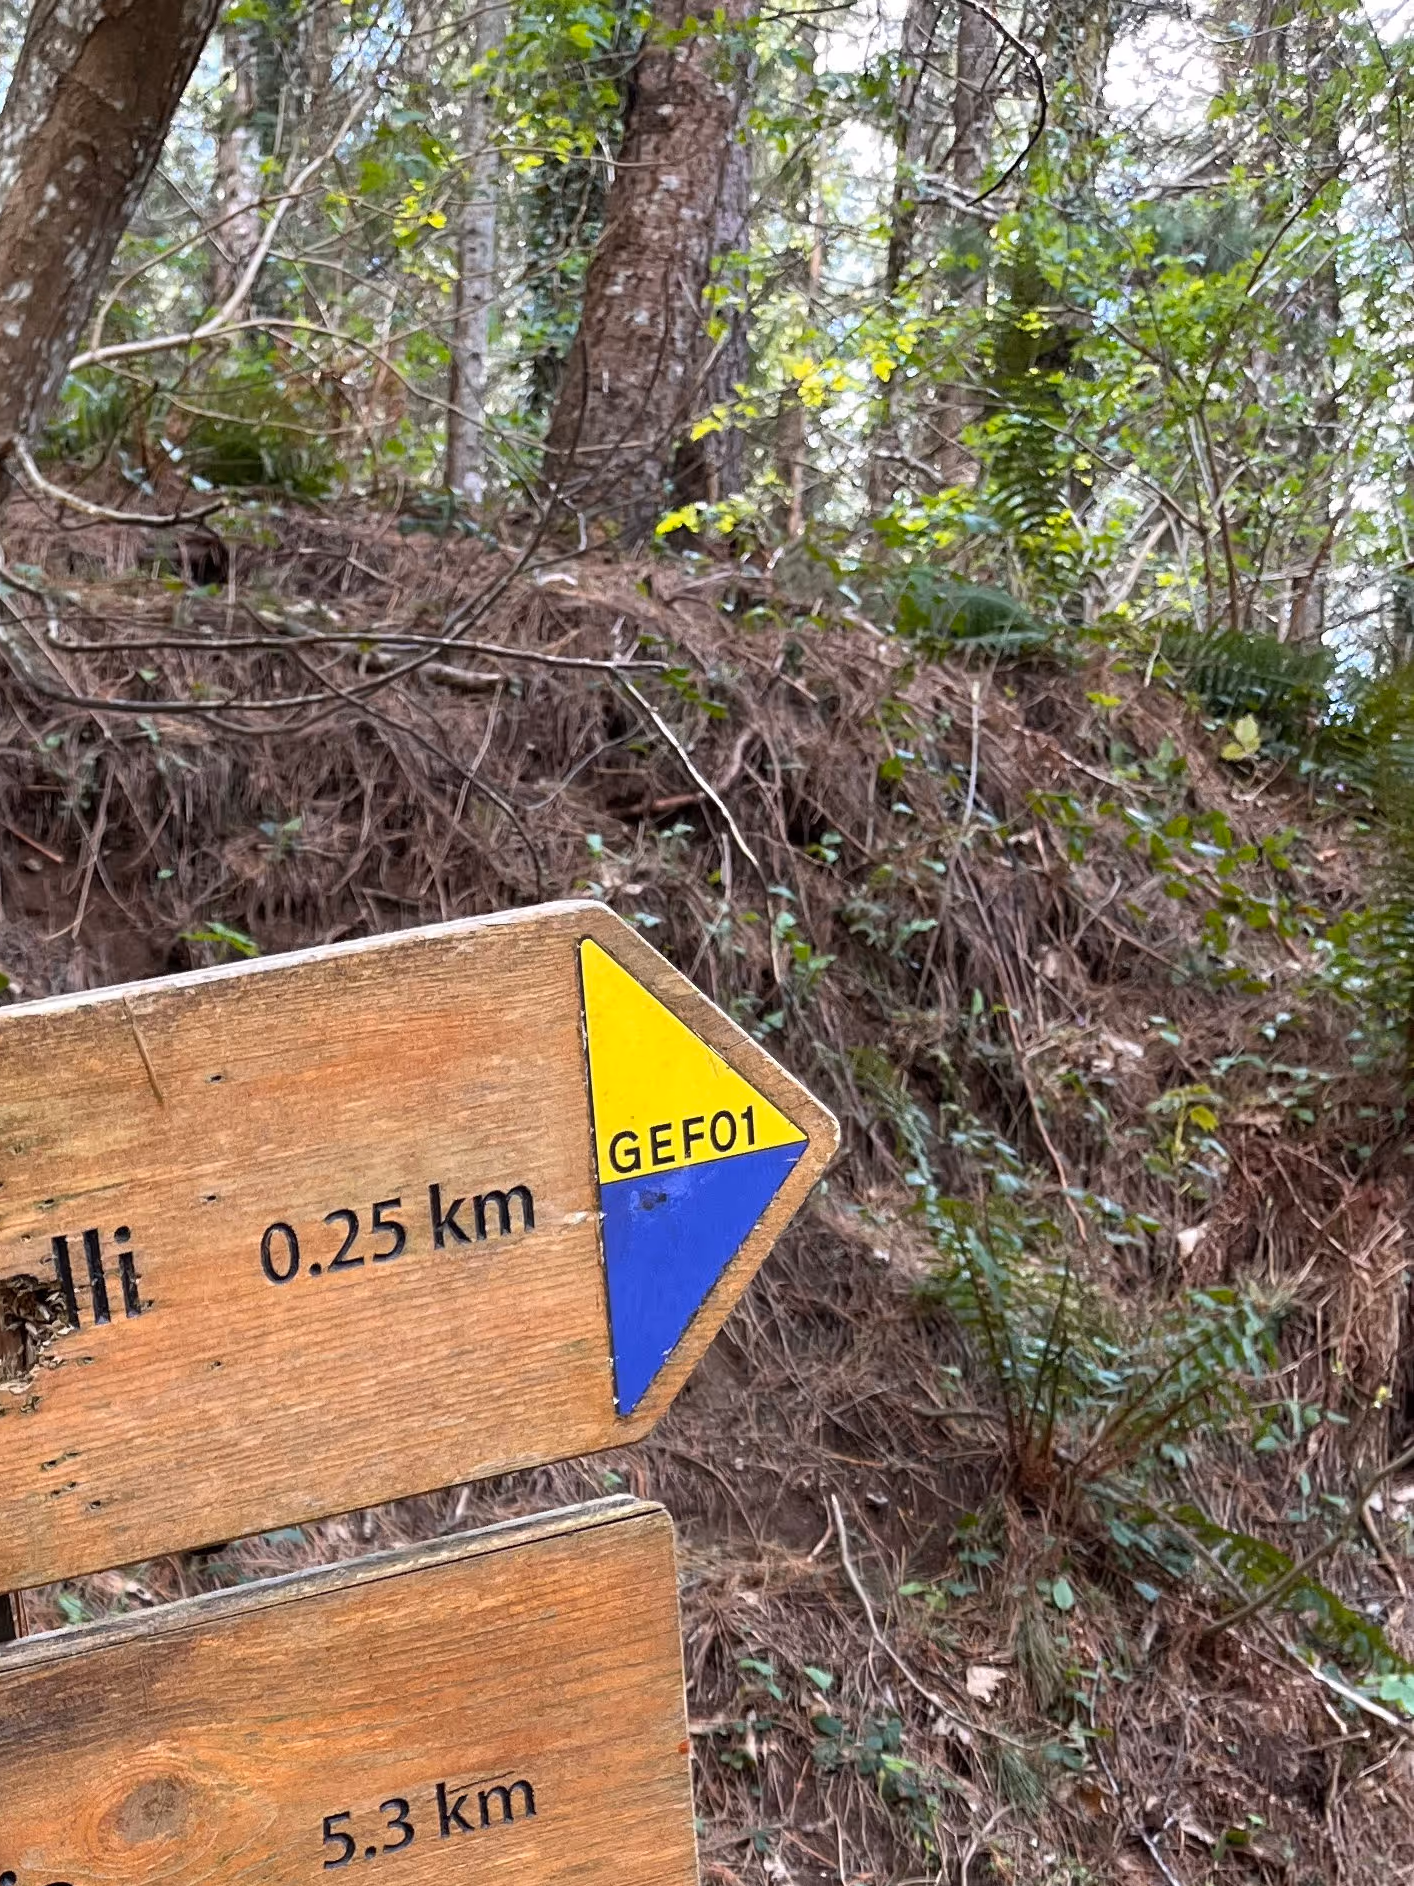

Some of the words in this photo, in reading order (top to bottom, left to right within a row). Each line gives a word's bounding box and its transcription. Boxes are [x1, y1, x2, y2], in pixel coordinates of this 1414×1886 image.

[609, 1105, 758, 1174] GEF01
[259, 1196, 408, 1286] 0.25
[428, 1182, 537, 1250] km
[322, 1798, 415, 1870] 5.3
[435, 1778, 537, 1838] km
